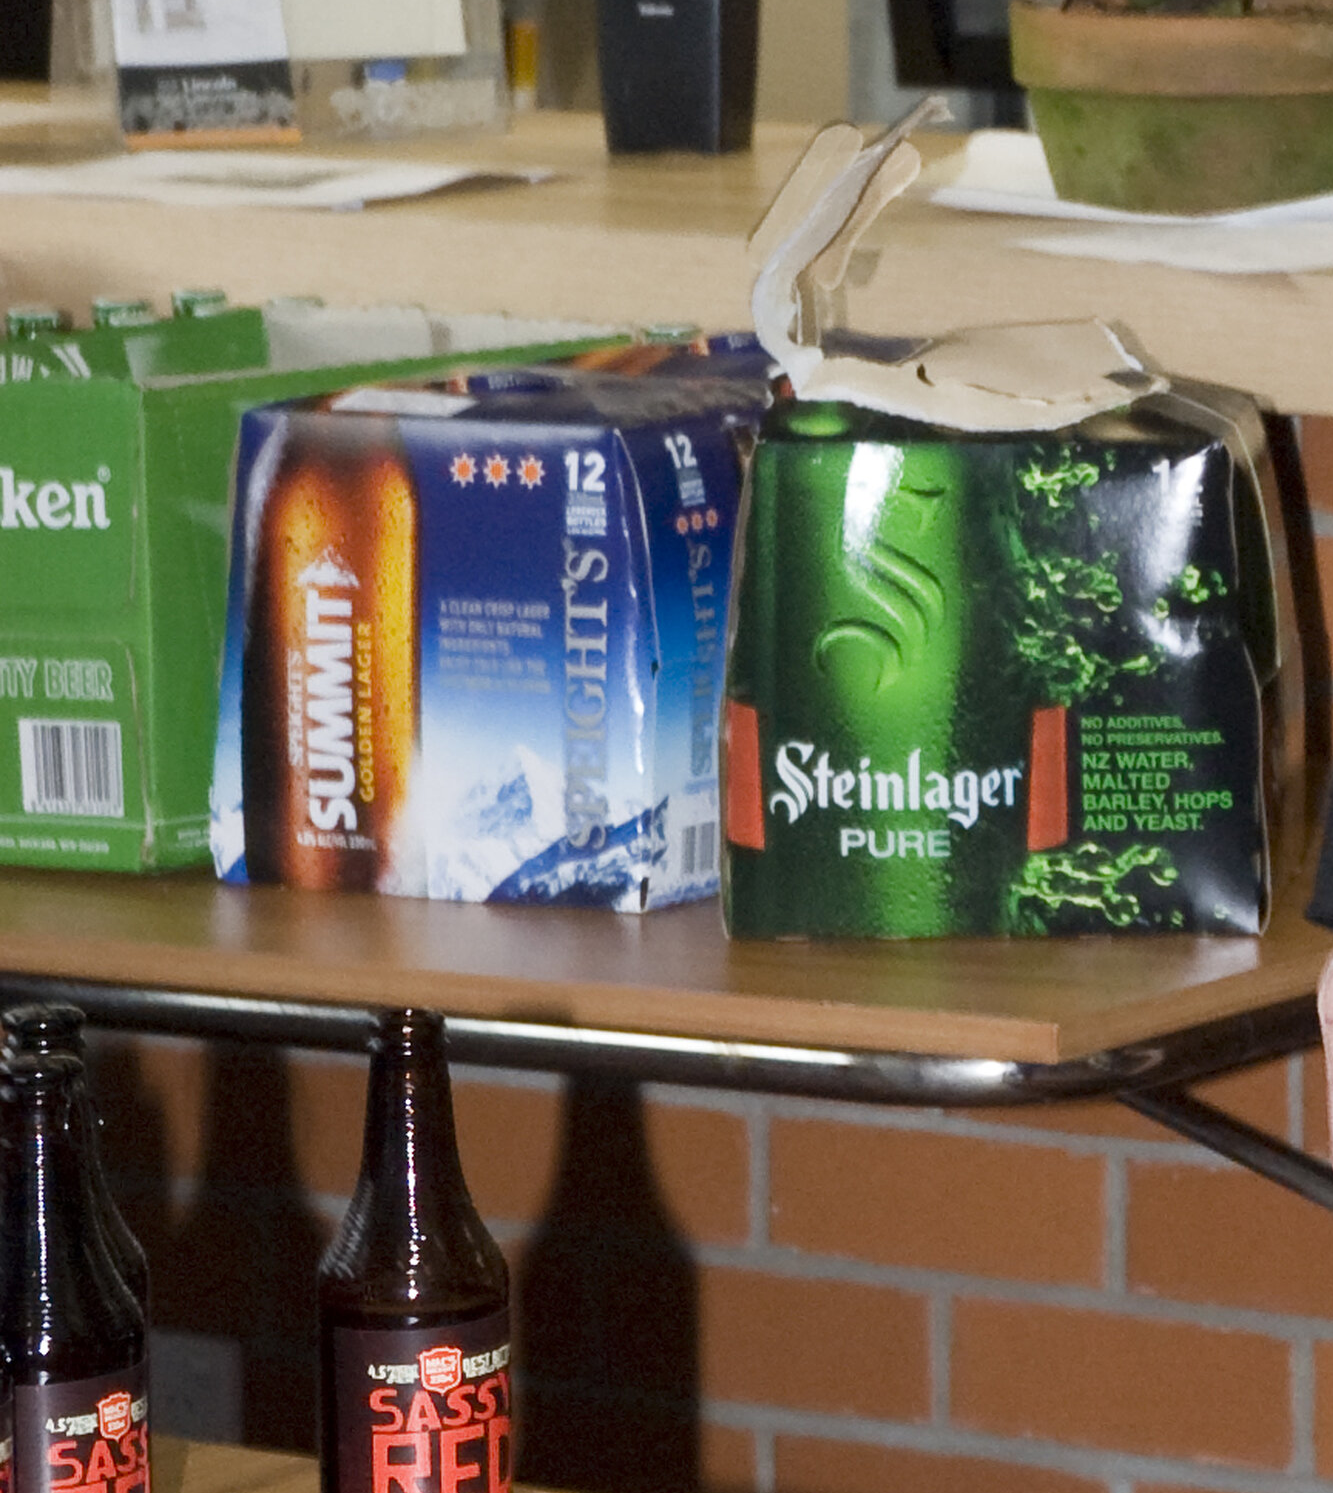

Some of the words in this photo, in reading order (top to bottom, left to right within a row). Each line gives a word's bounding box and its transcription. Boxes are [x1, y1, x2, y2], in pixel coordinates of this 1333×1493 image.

[664, 433, 697, 469] 12
[564, 449, 606, 491] 12
[356, 622, 373, 698] LAGER
[43, 659, 114, 702] BEER
[306, 589, 357, 832] SUMMIT
[1081, 717, 1103, 729] NO
[357, 704, 375, 803] GOLDEN
[1081, 734, 1103, 746] NO
[1082, 752, 1111, 769] NZ
[1116, 751, 1195, 772] WATER,
[769, 741, 1023, 830] Steinlager
[1082, 772, 1171, 790] MALTED
[1082, 792, 1169, 813] BARLEY,
[1174, 790, 1233, 810] HOPS
[1082, 813, 1128, 832] AND
[1133, 813, 1204, 832] YEAST.
[840, 827, 951, 859] PURE
